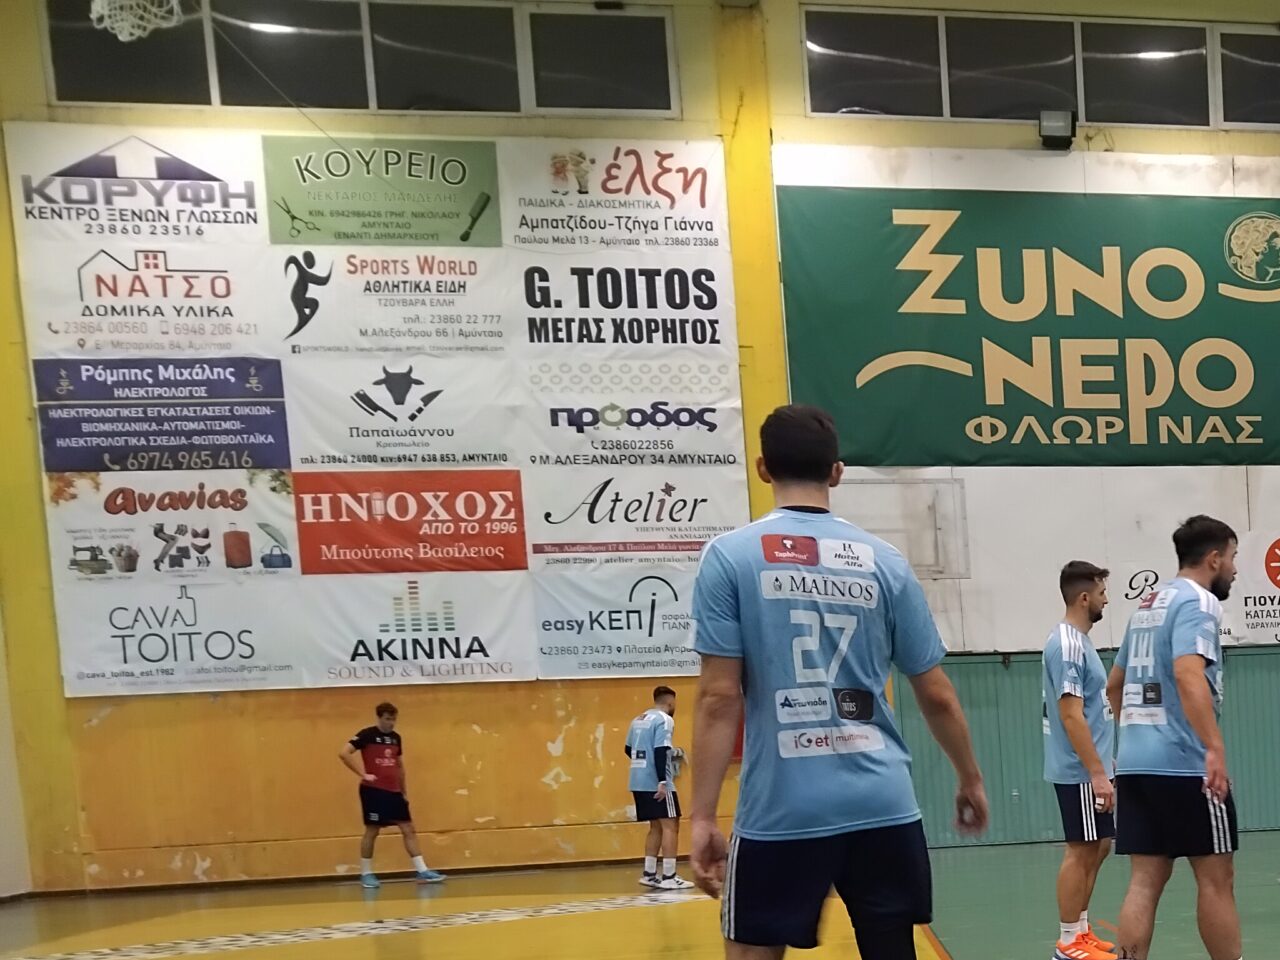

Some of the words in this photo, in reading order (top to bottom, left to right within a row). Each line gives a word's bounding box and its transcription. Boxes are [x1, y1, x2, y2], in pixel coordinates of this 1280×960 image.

[295, 149, 467, 185] ΚΟΥΡΕΙΟ
[601, 146, 707, 209] έλξη
[21, 175, 256, 209] ΚΟΡΥΦΗ
[519, 198, 565, 208] ΠΑΙΔΙΚΑ
[577, 199, 661, 210] ΔΙΑΚΟΣΜΗΤΙΚΑ
[24, 206, 99, 221] ΚΕΝΤΡΟ
[106, 209, 169, 223] ΞΕΝΩΝ
[177, 210, 258, 224] ΓΛΩΣΣΩΝ
[84, 223, 141, 234] 23860
[150, 224, 204, 236] 23516
[519, 214, 659, 234] Αμπατζίδου-Τζήγα
[664, 217, 713, 231] Γιάννα
[514, 235, 549, 244] Παύλου
[552, 236, 576, 244] Μελά
[579, 236, 589, 244] 13
[600, 236, 640, 246] Αμύνταιο
[694, 238, 719, 246] 23368
[95, 274, 231, 298] ΝΑΤΣΟ
[364, 281, 431, 293] ΑΘΛΗΤΙΚΑ
[436, 281, 466, 293] ΕΙΔΗ
[524, 266, 562, 308] G.
[570, 267, 717, 310] TOITOS
[82, 305, 165, 317] ΔΟΜΙΚΑ
[173, 305, 234, 317] ΥΛΙΚΑ
[429, 314, 462, 323] 23860
[466, 315, 478, 323] 22
[482, 315, 501, 323] 777
[174, 323, 206, 335] 6948
[210, 323, 232, 335] 206
[236, 324, 258, 335] 421
[528, 318, 606, 343] ΜΕΓΑΣ
[612, 318, 720, 344] ΧΟΡΗΓΟΣ
[80, 365, 153, 384] Ρόμπης
[158, 364, 235, 382] Μιχάλης
[114, 387, 208, 398] ΗΛΕΚΤΡΟΛΟΓΟΣ
[48, 407, 144, 418] ΗΛΕΚΤΡΟΛΟΓΙΚΕΣ
[147, 407, 230, 417] ΕΓΚΑΤΑΣΤΑΣΕΙΣ
[349, 426, 454, 438] Παπαϊωάννου
[56, 437, 147, 447] ΗΛΕΚΤΡΟΛΟΓΙΚΑ
[601, 440, 674, 450] 2386022856
[127, 453, 173, 470] 6974
[178, 452, 213, 469] 965
[218, 451, 253, 468] 416
[462, 453, 508, 463] ΑΜΥΝΤΑΙΟ
[539, 454, 645, 465] Μ.ΑΛΕΞΑΝΔΡΟΥ
[651, 455, 664, 464] 34
[669, 455, 736, 464] ΑΜΥΝΤΑΙΟ
[544, 478, 708, 524] Atelier
[420, 522, 454, 535] ΑΠΟ
[459, 523, 479, 534] ΤΟ
[485, 522, 517, 534] 1996
[320, 545, 413, 560] Μπούτσης
[418, 543, 504, 560] Βασίλειος
[542, 620, 584, 634] easy
[111, 630, 255, 664] TOITOS
[350, 637, 490, 662] AKINNA
[548, 647, 579, 655] 23860
[582, 646, 612, 655] 23473
[790, 609, 857, 683] 27
[328, 665, 395, 680] SOUND
[420, 662, 513, 677] LIGHTING
